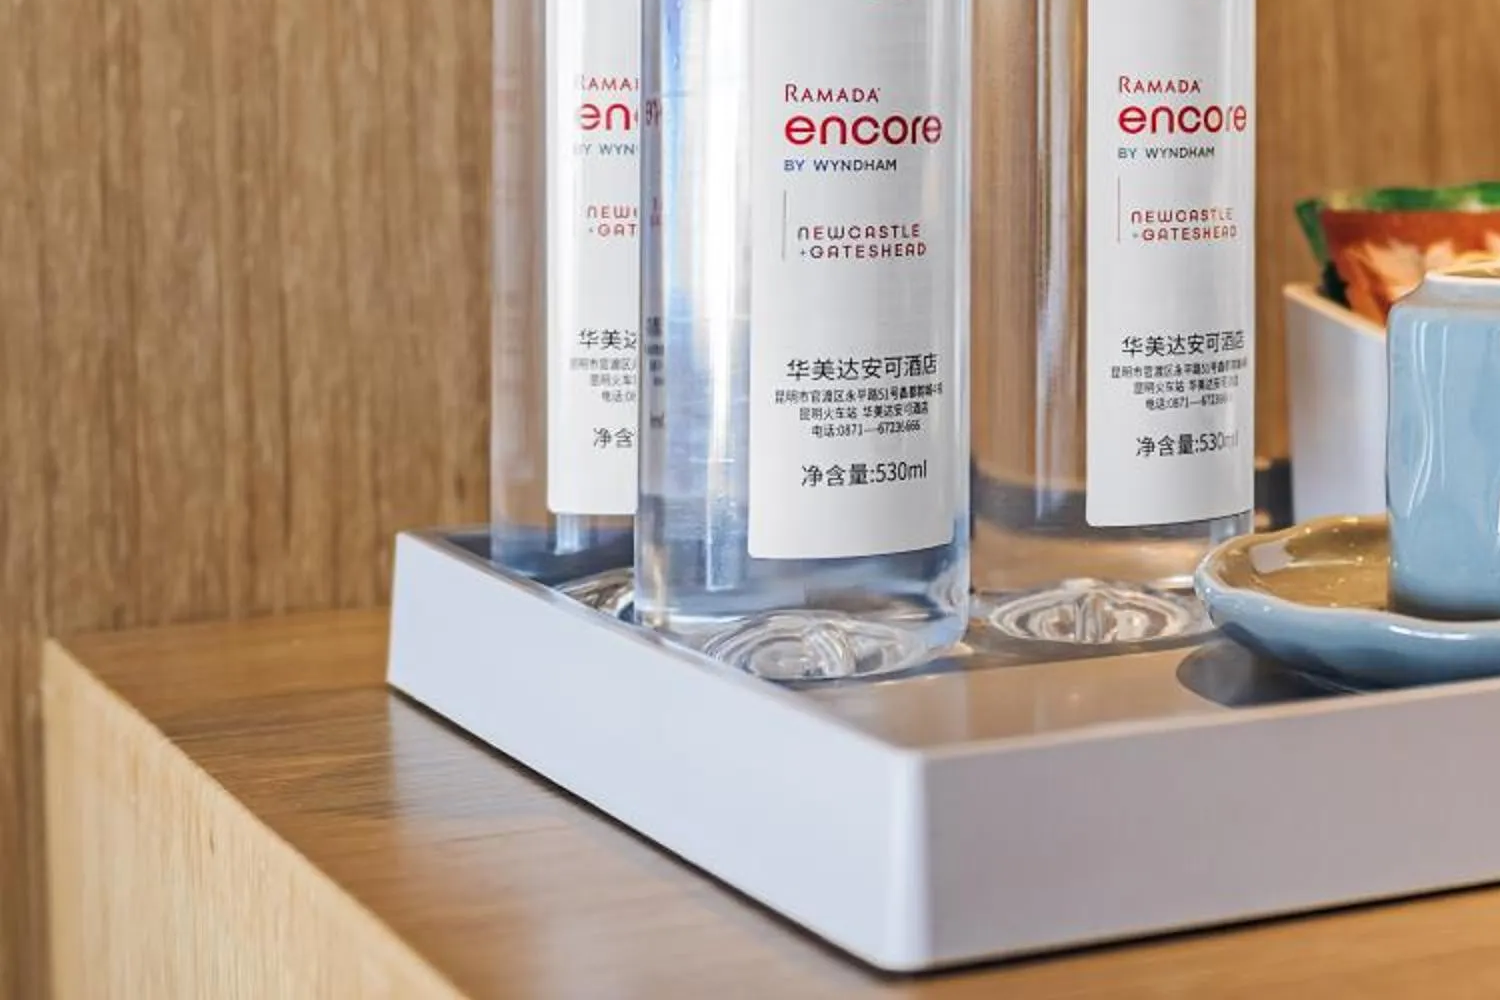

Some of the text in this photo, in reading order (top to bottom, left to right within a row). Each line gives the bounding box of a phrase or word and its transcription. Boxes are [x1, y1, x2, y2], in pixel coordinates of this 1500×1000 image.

[582, 75, 638, 91] AMA
[785, 83, 880, 103] RAMADA
[1118, 75, 1201, 94] RAMADA
[580, 103, 638, 131] en
[1118, 105, 1247, 134] encore
[785, 115, 942, 145] encore
[599, 143, 638, 155] WYN
[1117, 146, 1215, 159] BY WYNDHAM
[784, 159, 898, 171] BY WYNDHAM
[786, 352, 938, 381] 华美达安可酒店
[801, 459, 928, 487] 净含量:530ml
